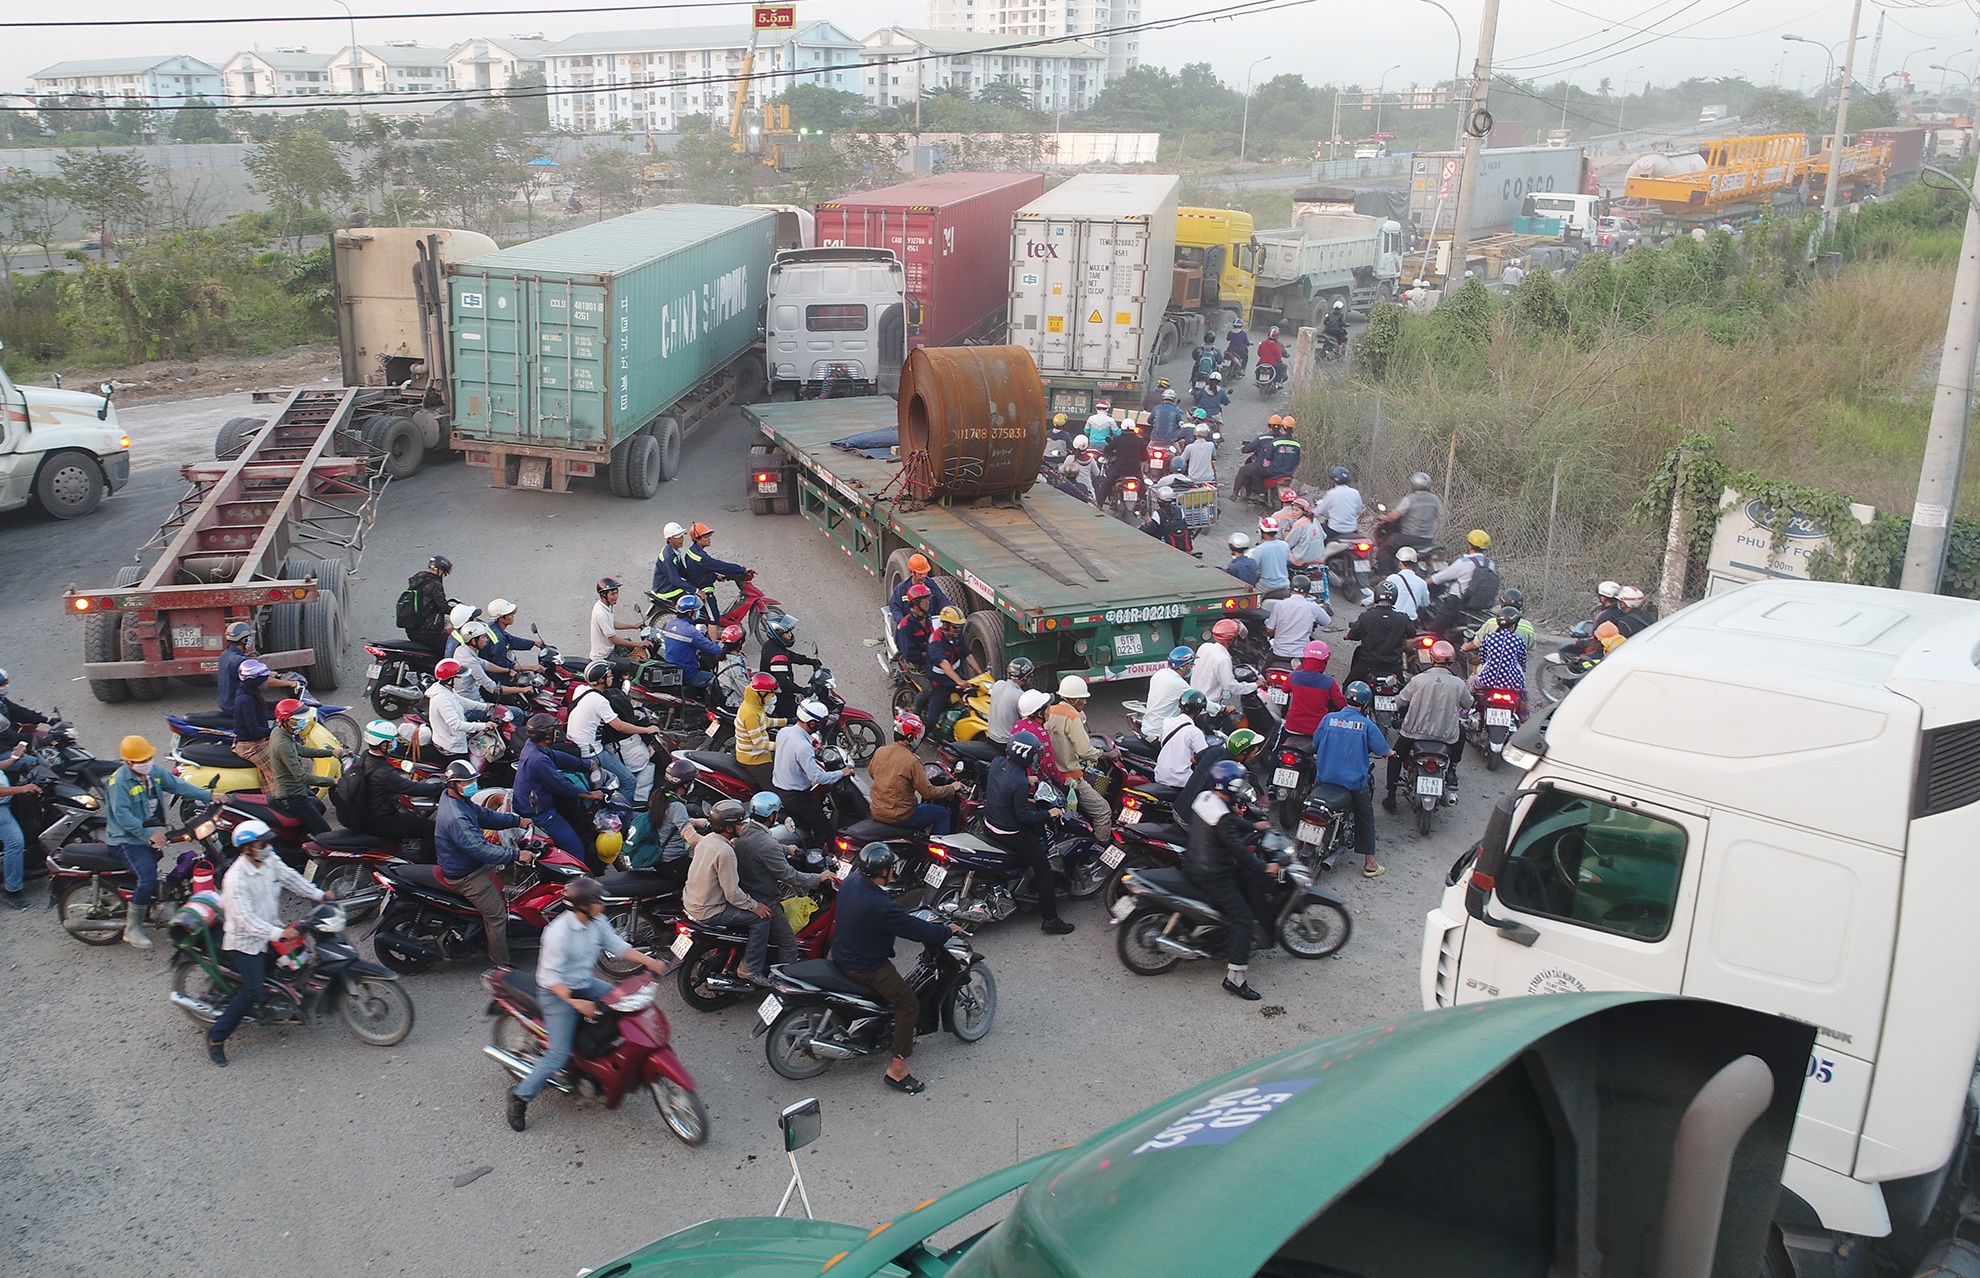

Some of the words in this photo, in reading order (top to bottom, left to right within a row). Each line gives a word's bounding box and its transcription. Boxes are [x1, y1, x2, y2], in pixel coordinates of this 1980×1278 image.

[758, 13, 790, 23] 5.5m
[1503, 174, 1554, 200] COSCO
[1026, 238, 1058, 258] tex
[662, 290, 696, 358] CHINA
[703, 264, 747, 334] SHIPPING
[179, 628, 194, 638] 61R
[1121, 636, 1134, 645] 61R
[1146, 664, 1165, 672] NAM
[1330, 718, 1353, 728] Mobil
[1235, 738, 1249, 748] Grab
[1012, 741, 1032, 758] 777
